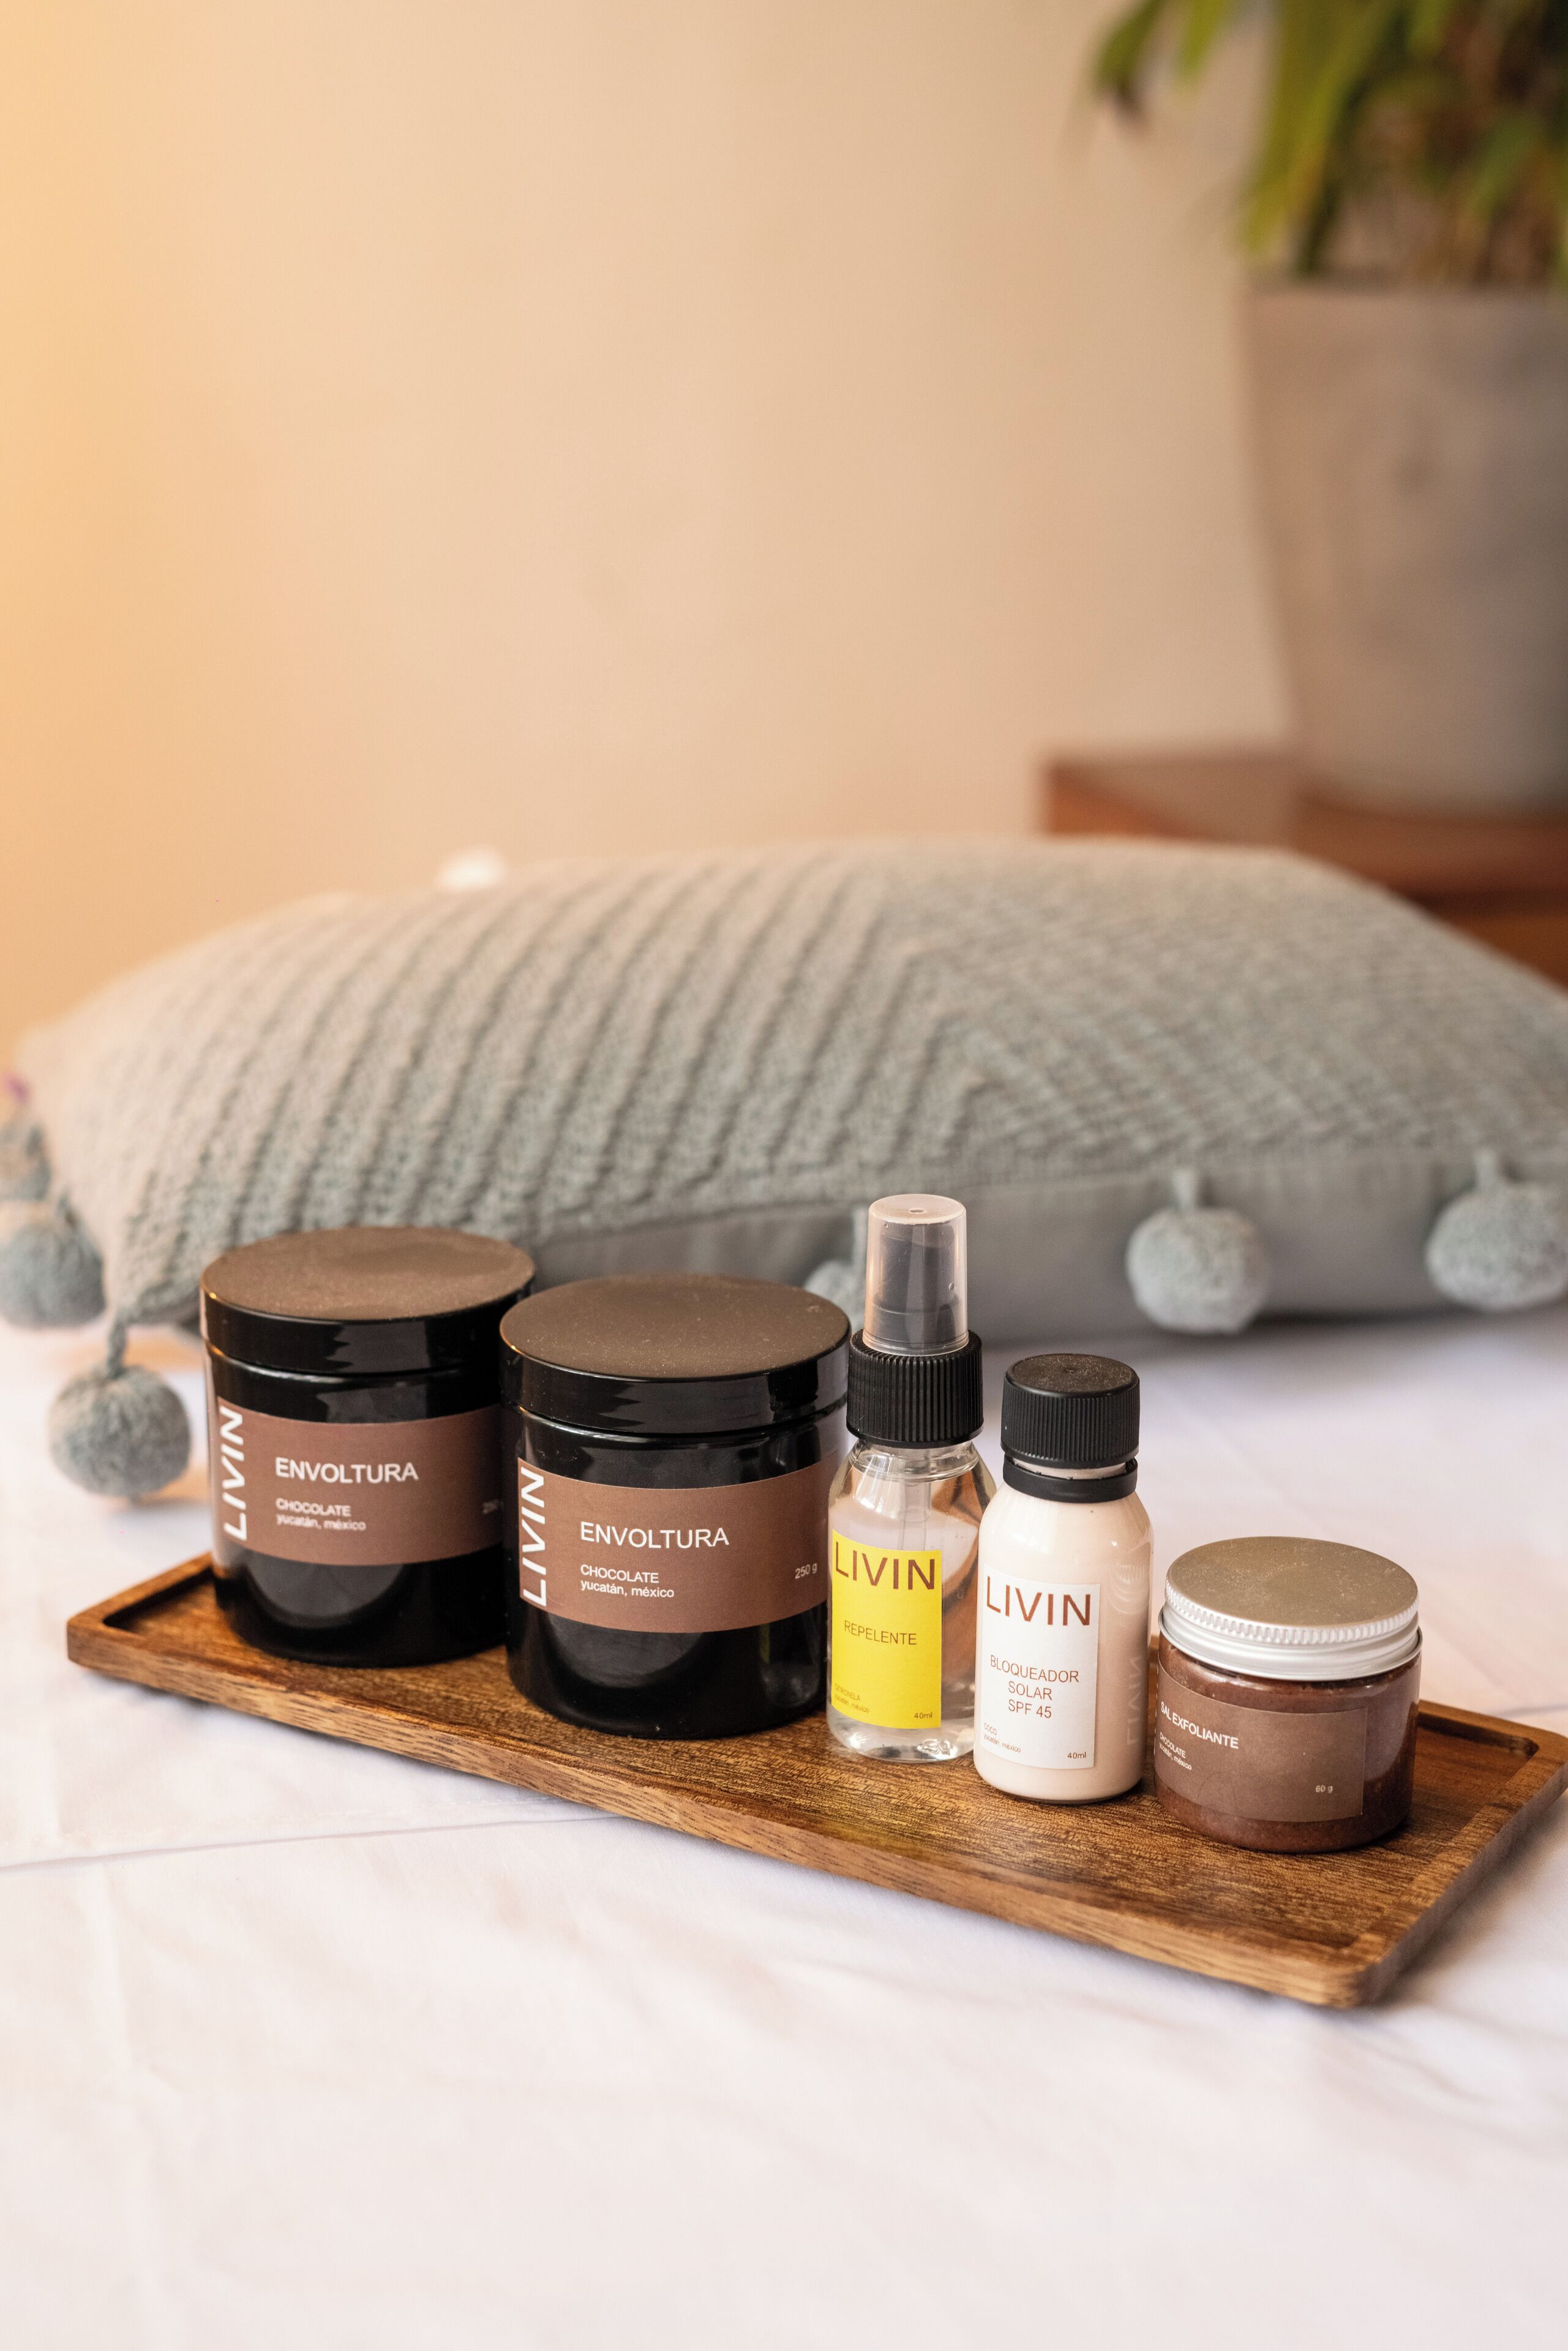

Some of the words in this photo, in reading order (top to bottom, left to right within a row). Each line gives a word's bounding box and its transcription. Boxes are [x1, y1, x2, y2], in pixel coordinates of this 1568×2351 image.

[220, 1406, 247, 1541] LIVIN
[275, 1457, 419, 1483] ENVOLTURA
[276, 1498, 351, 1517] CHOCOLATE
[520, 1467, 547, 1607] LIVIN
[580, 1521, 730, 1549] ENVOLTURA
[580, 1564, 659, 1584] CHOCOLATE
[795, 1565, 811, 1579] 250
[812, 1563, 818, 1574] g
[836, 1541, 936, 1590] LIVIN
[580, 1579, 628, 1597] yucatán,
[631, 1581, 675, 1599] méxico
[987, 1575, 1091, 1626] LIVIN
[844, 1620, 917, 1645] REPELENTE
[991, 1654, 1079, 1683] BLOQUEADOR
[1008, 1681, 1052, 1701] SOLAR
[1008, 1700, 1033, 1715] SPF
[1036, 1706, 1052, 1719] 45
[1160, 1701, 1172, 1721] SAL
[1172, 1712, 1240, 1750] EXFOLIANTE
[1160, 1732, 1186, 1759] CHOCOLATE
